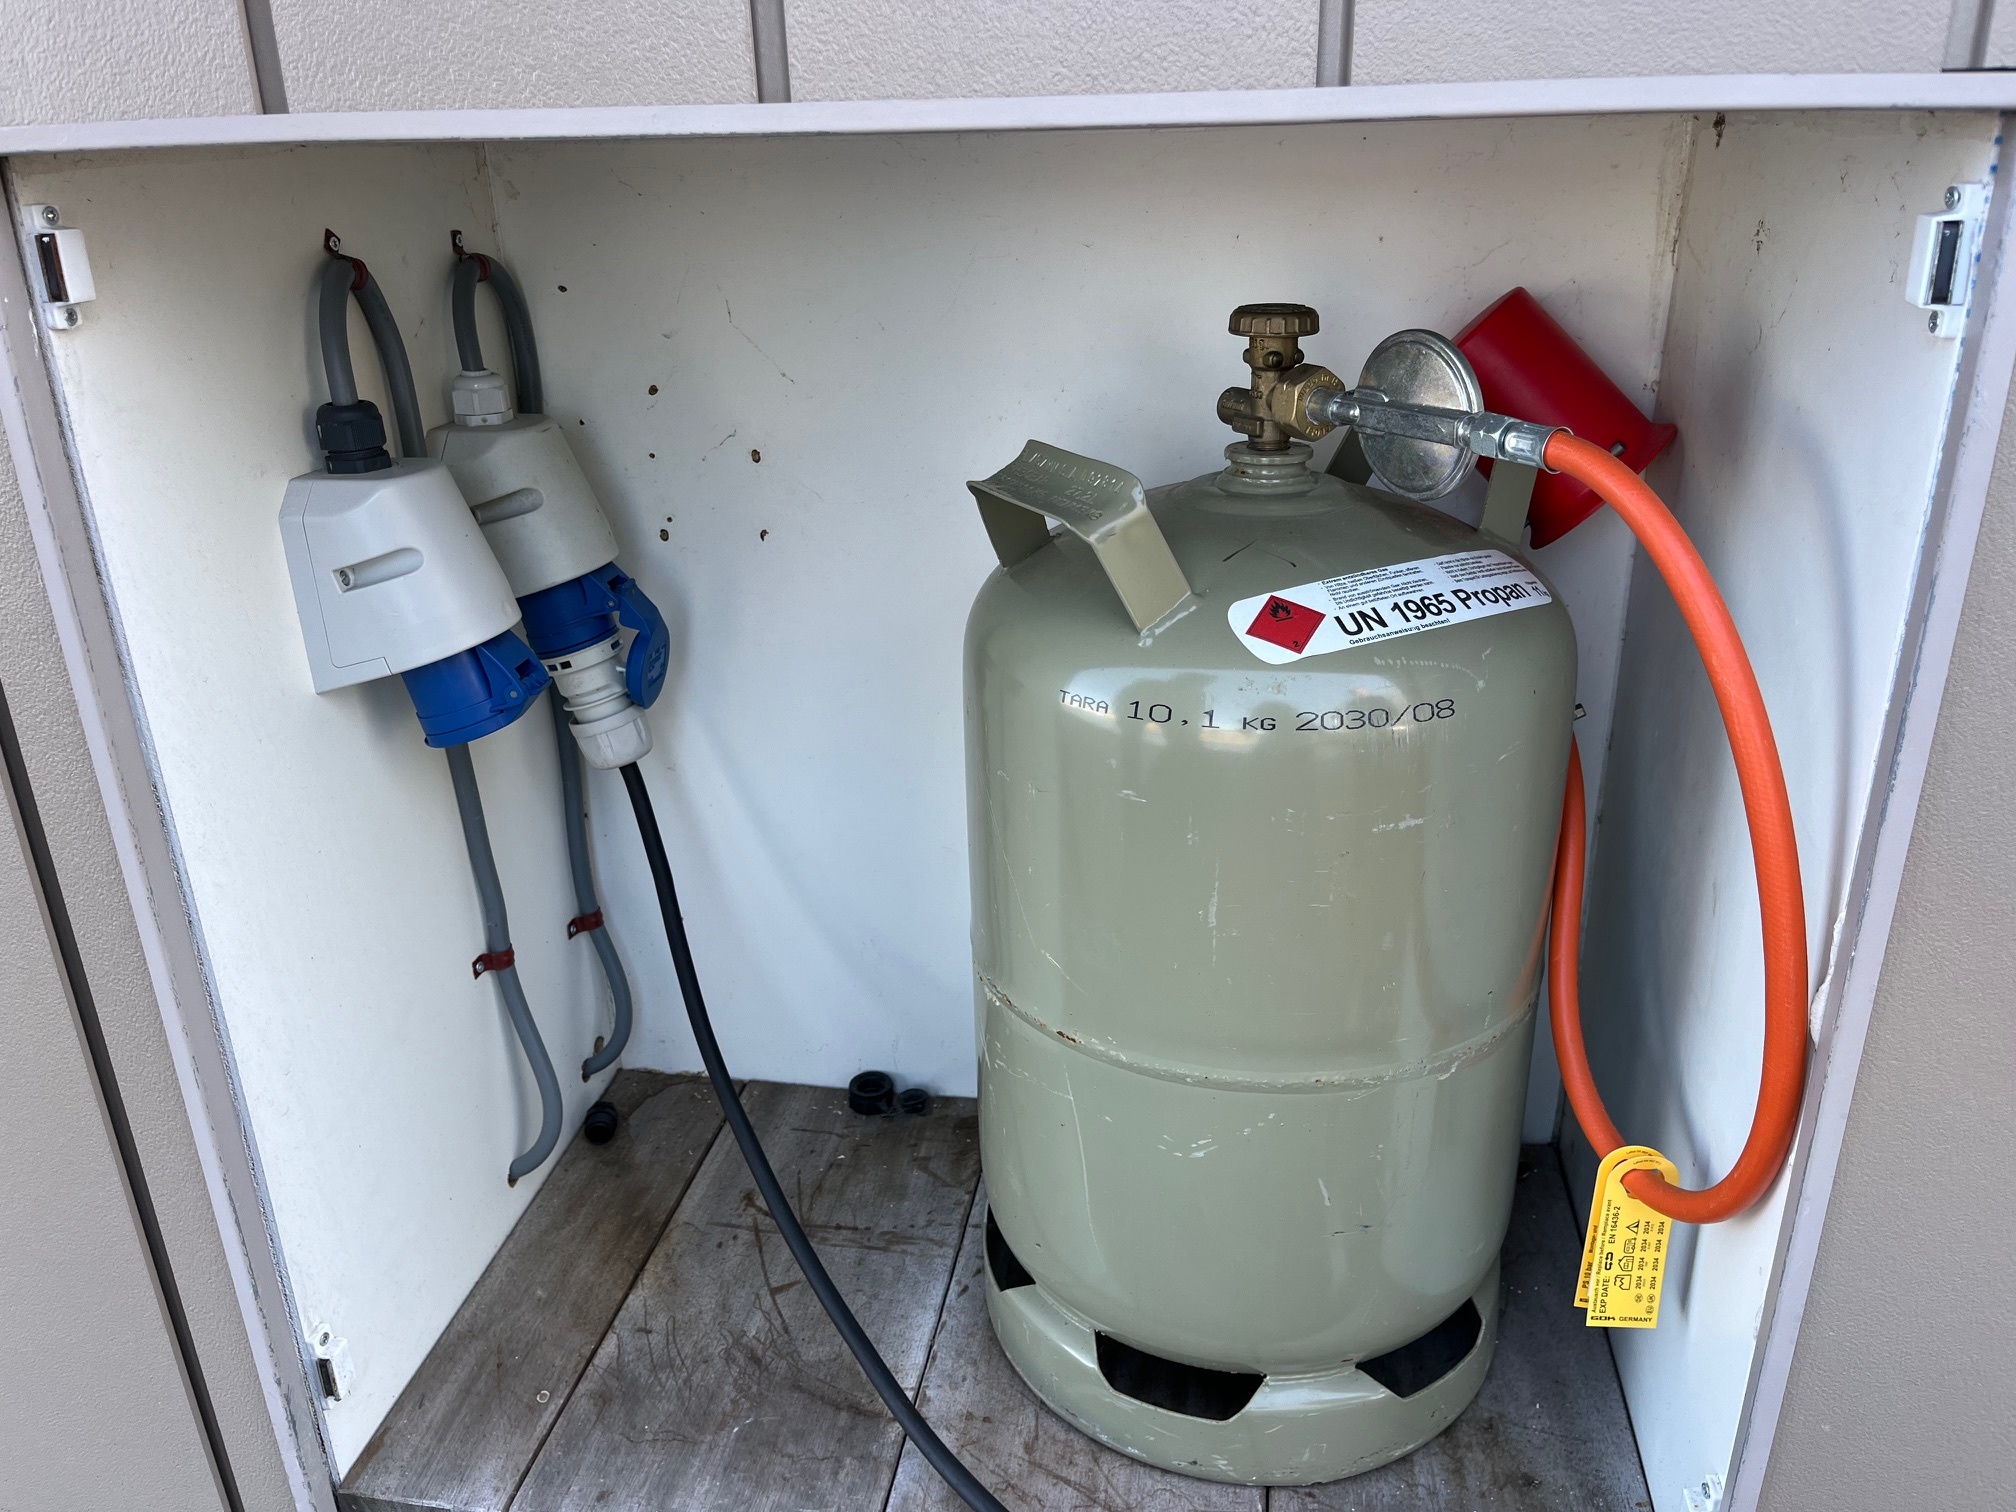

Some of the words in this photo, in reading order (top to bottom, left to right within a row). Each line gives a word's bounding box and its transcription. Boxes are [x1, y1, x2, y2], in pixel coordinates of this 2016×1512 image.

[1334, 607, 1388, 636] UN
[1391, 594, 1456, 622] 1965
[1450, 583, 1531, 610] Propan
[1349, 625, 1421, 645] Gebrauchsanweisung
[1420, 618, 1450, 629] beachten!
[1293, 640, 1301, 648] 2
[1059, 690, 1109, 714] TARA
[1242, 717, 1276, 732] KG
[1295, 699, 1455, 732] 2030/08
[1610, 1206, 1620, 1232] 16436-2
[1608, 1234, 1615, 1243] EN
[1601, 1276, 1610, 1297] DATE:
[1599, 1299, 1607, 1313] EXP
